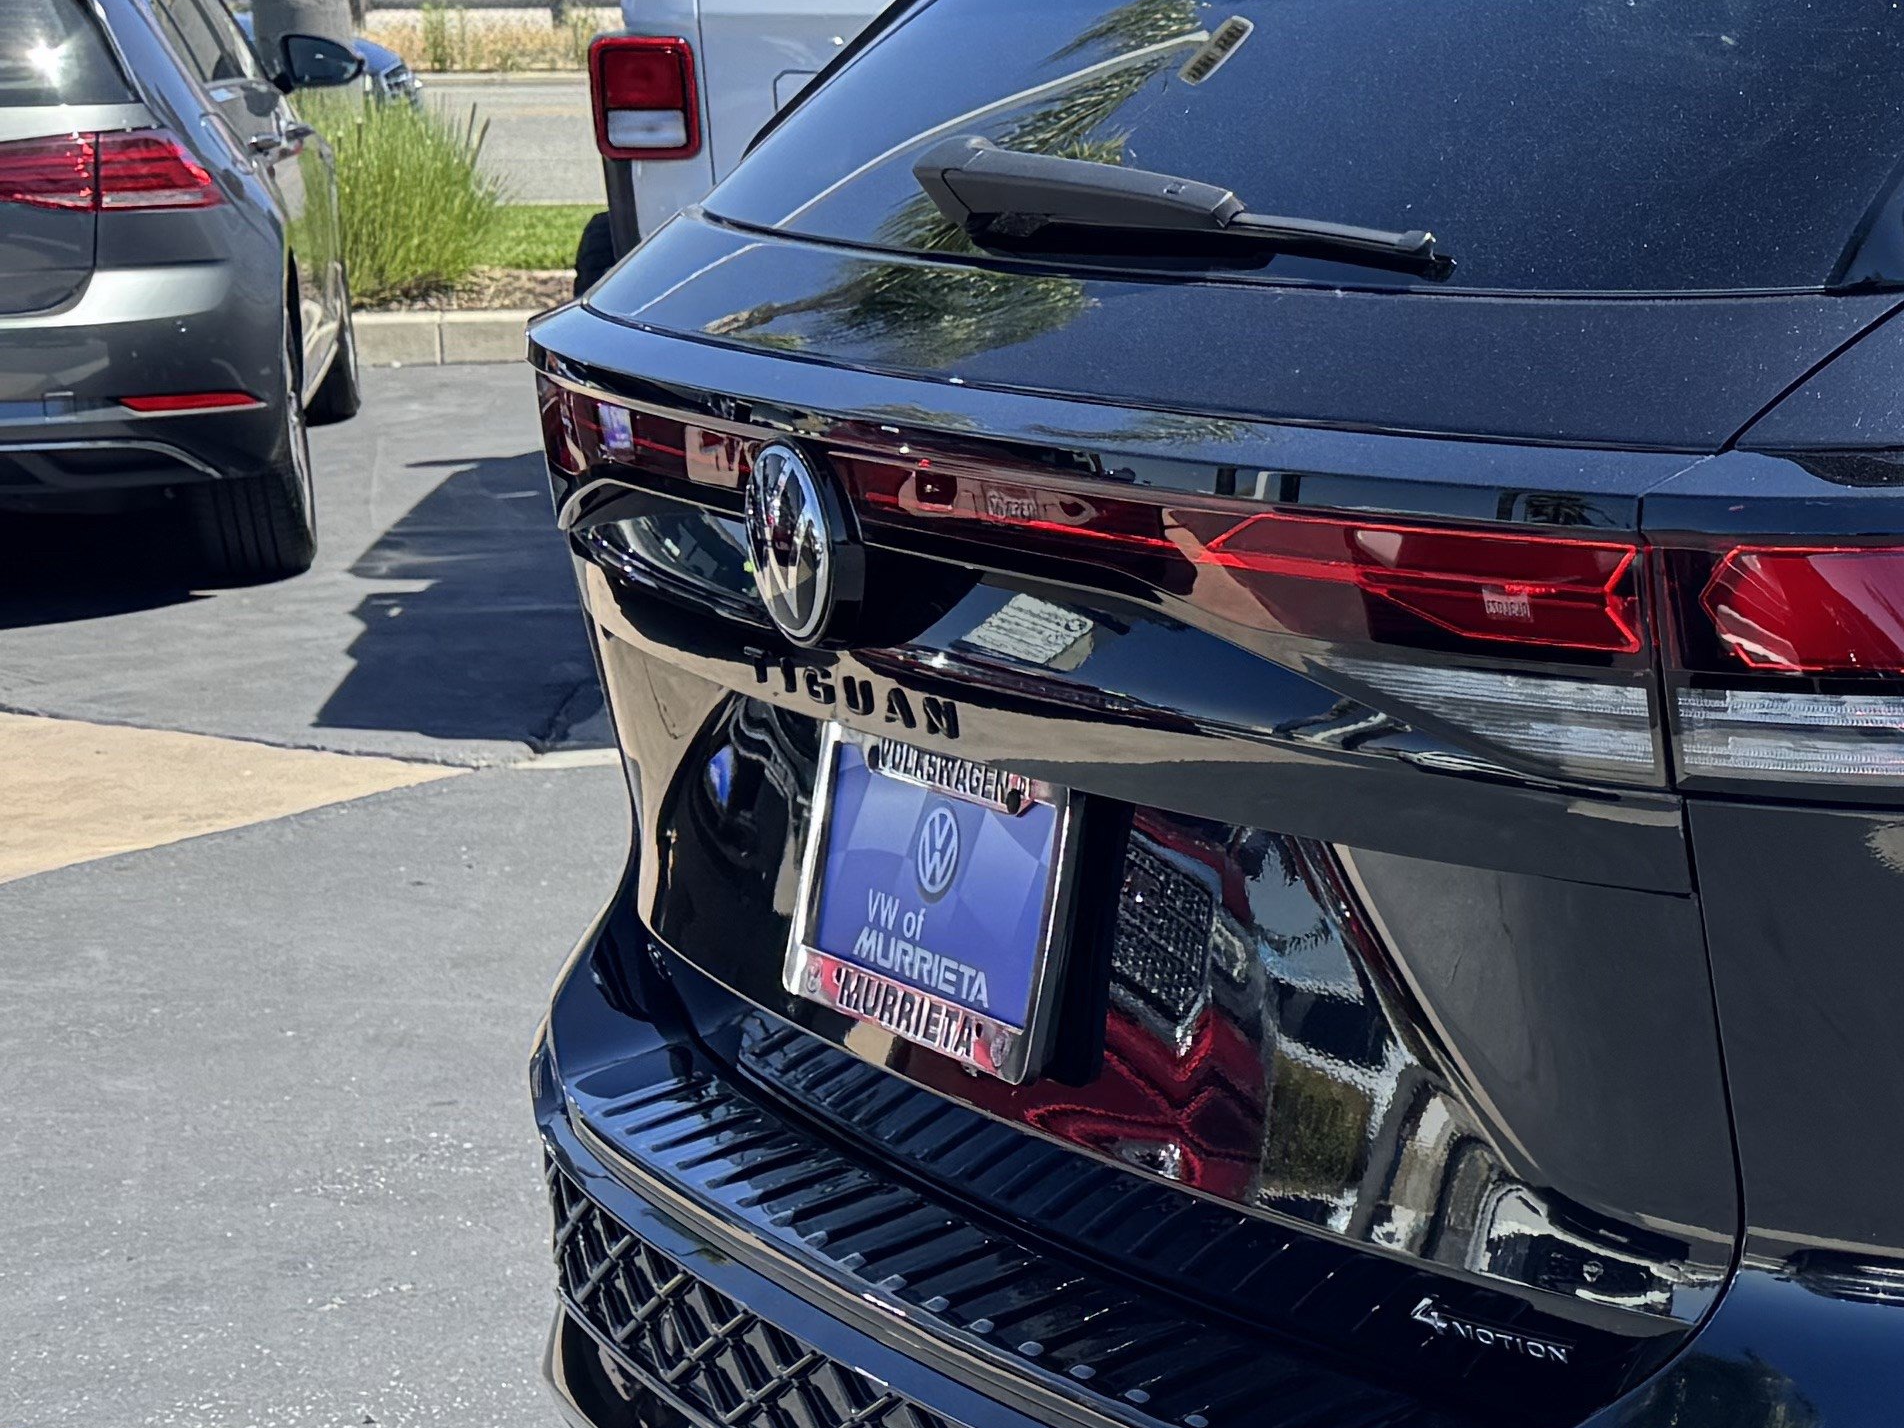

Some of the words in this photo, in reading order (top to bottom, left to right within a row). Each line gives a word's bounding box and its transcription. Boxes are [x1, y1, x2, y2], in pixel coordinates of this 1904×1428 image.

[743, 646, 960, 740] TIGUAN
[868, 888, 900, 931] VW
[902, 907, 926, 941] of
[852, 925, 990, 1009] MURRIETA
[836, 966, 976, 1060] MURRIETA
[1409, 1295, 1569, 1365] 4MOTION
